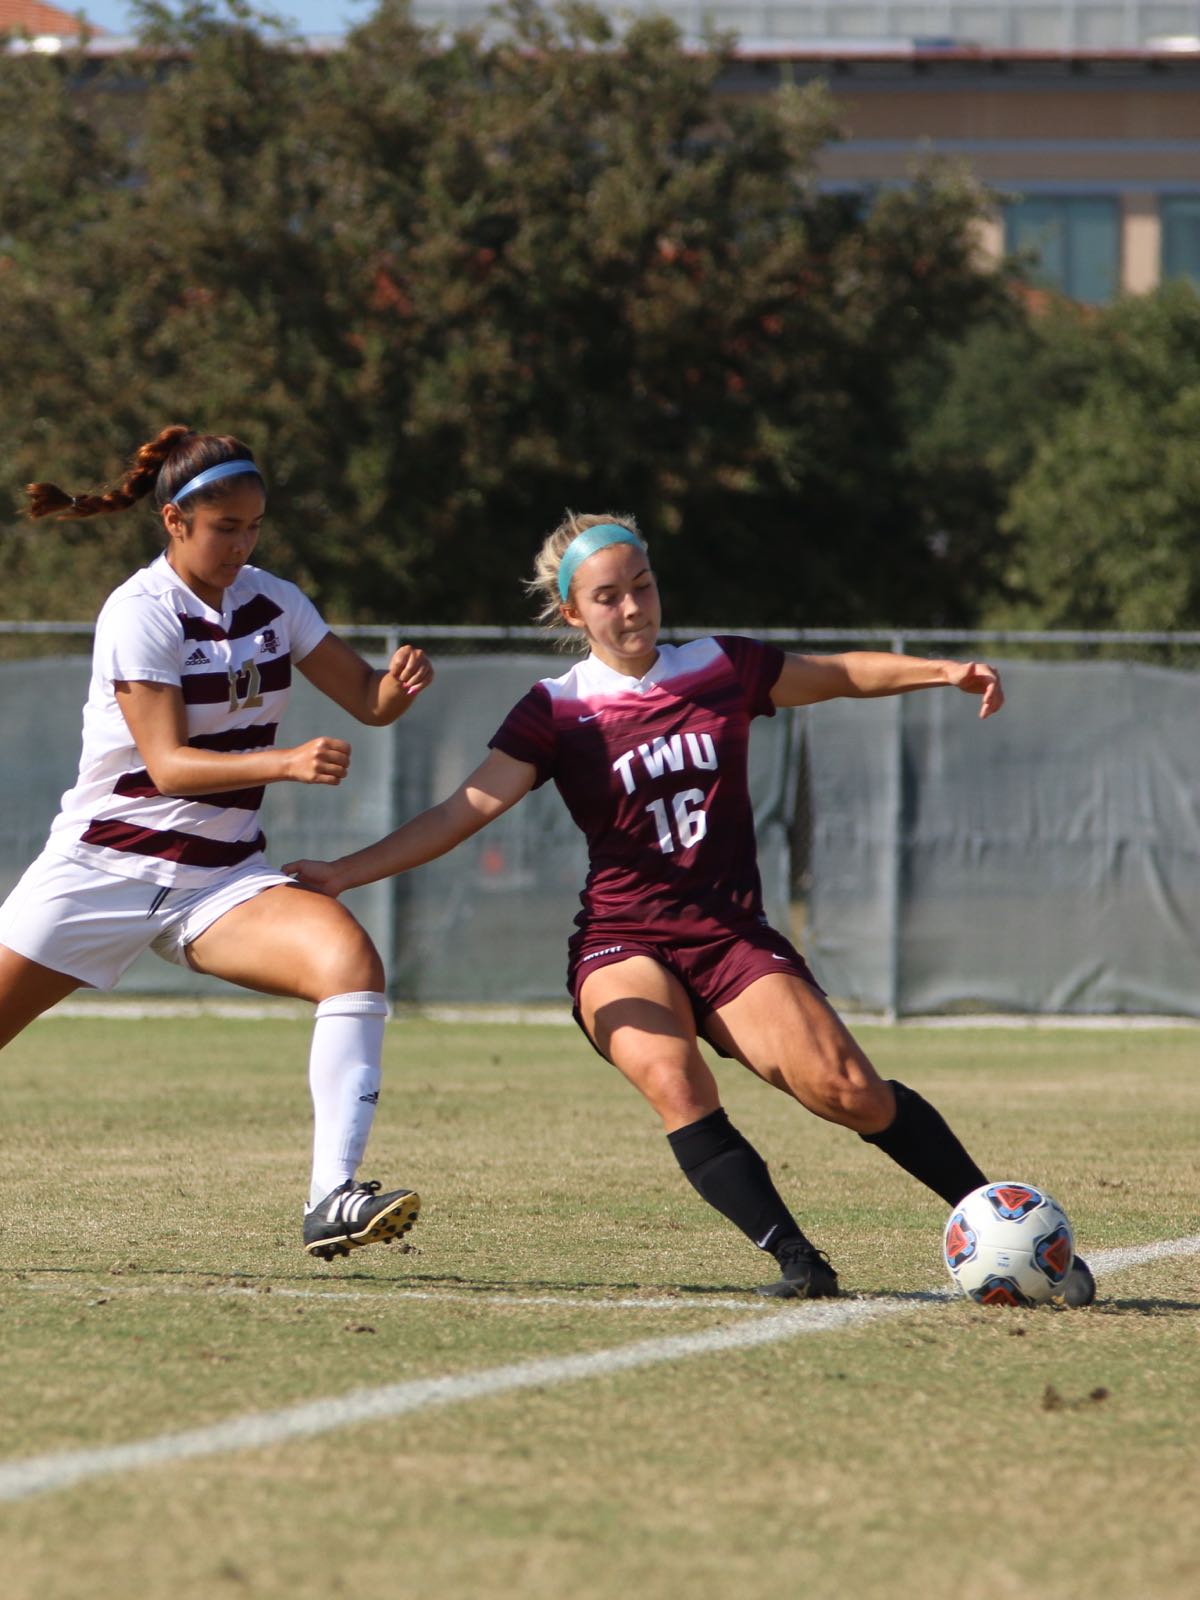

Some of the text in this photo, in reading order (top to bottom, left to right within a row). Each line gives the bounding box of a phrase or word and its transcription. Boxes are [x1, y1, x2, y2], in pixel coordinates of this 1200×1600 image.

[185, 658, 211, 666] adidas
[228, 658, 264, 714] 12
[612, 733, 718, 795] TWU
[645, 788, 707, 854] 16
